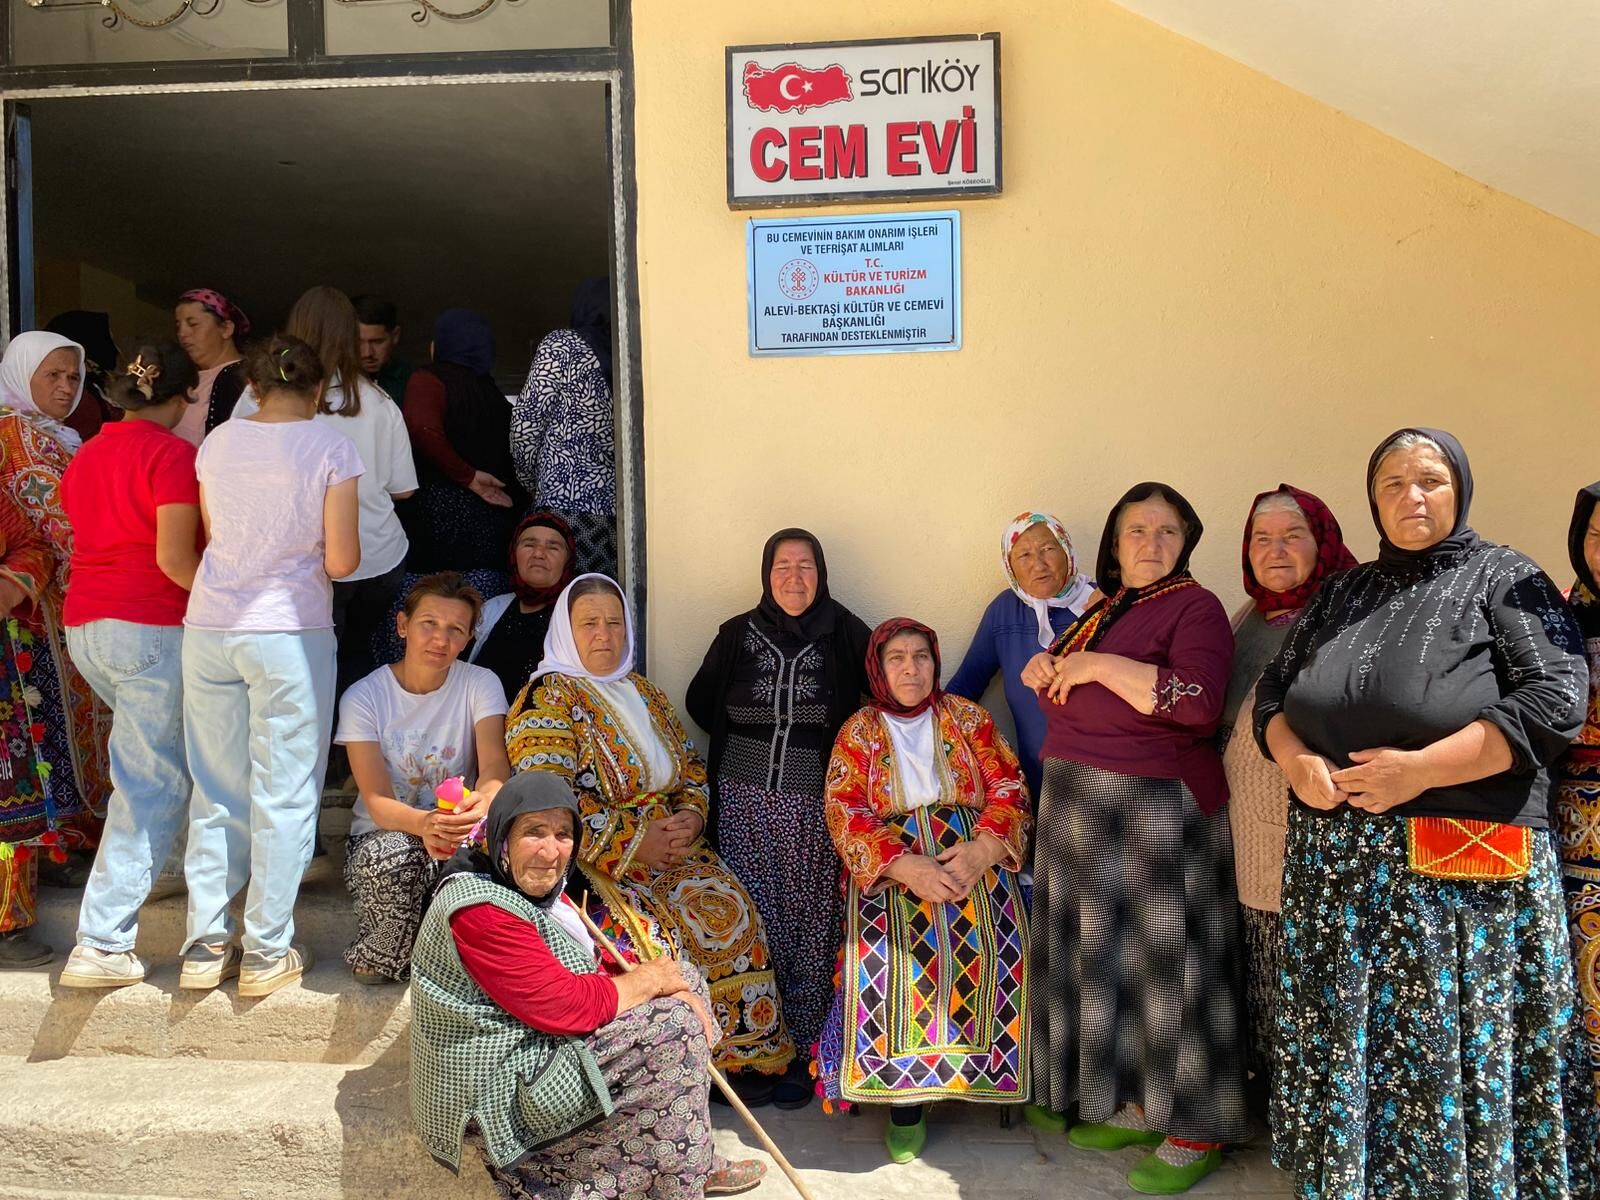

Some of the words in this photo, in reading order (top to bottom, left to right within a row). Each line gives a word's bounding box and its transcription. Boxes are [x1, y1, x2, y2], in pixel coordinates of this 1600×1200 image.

[750, 124, 868, 182] CEM
[887, 105, 977, 176] EVİ
[767, 234, 779, 243] BU
[782, 231, 833, 242] CEMEVİNİN
[836, 230, 865, 240] BAKIM
[868, 229, 905, 239] ONARIM
[908, 226, 938, 238] İŞLERİ
[801, 245, 812, 255] VE
[815, 242, 857, 255] TEFRİŞAT
[860, 241, 904, 252] ALIMLARI
[865, 258, 883, 268] T.C.
[824, 270, 866, 283] KÜLTÜR
[869, 272, 883, 281] VE
[886, 268, 926, 280] TURİZM
[846, 284, 904, 296] BAKANLIĞI
[764, 302, 840, 316] ALEVİ-BEKTAŞİ
[844, 300, 884, 314] KÜLTÜR
[887, 302, 901, 312] VE
[904, 297, 944, 311] CEMEVİ
[823, 314, 885, 329] BAŞKANLIĞI
[782, 332, 839, 343] TARAFINDAN
[842, 328, 926, 341] DESTEKLENMİŞTİR
